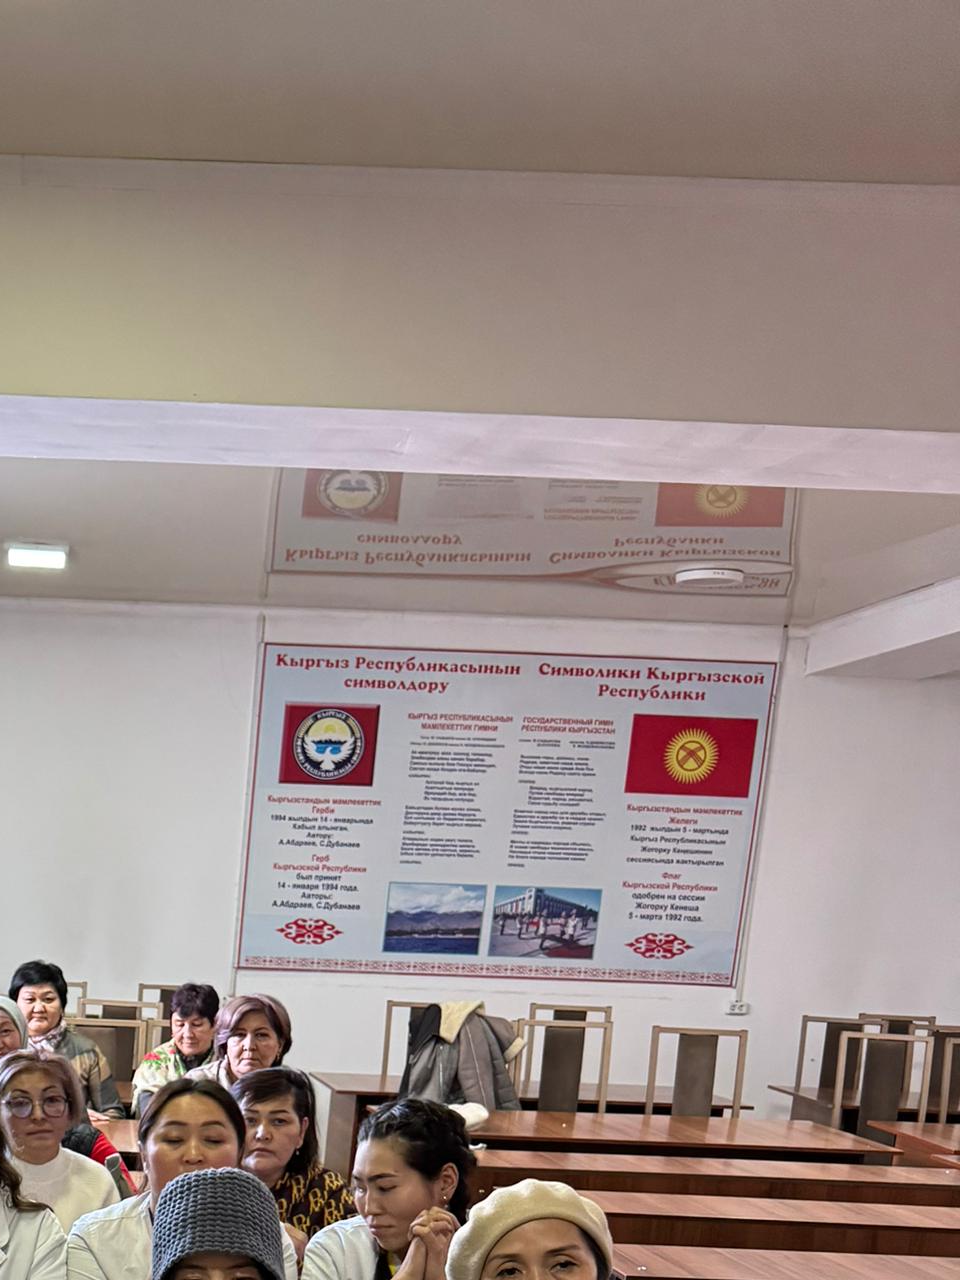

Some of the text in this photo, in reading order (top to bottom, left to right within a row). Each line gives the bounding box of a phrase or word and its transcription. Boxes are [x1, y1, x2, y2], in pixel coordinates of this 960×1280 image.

[276, 653, 521, 675] Кыргыз Республикасынын
[539, 663, 765, 685] Символики Кыргызской
[344, 678, 449, 693] символдору
[598, 684, 706, 701] Республики
[312, 806, 335, 814] Герби
[312, 854, 330, 863] Герб
[273, 863, 367, 874] Кыргызской Республики
[622, 881, 718, 892] Кыргызской Республики
[632, 892, 665, 900] одобрен
[635, 902, 668, 911] Жогорку
[665, 913, 682, 921] 1992
